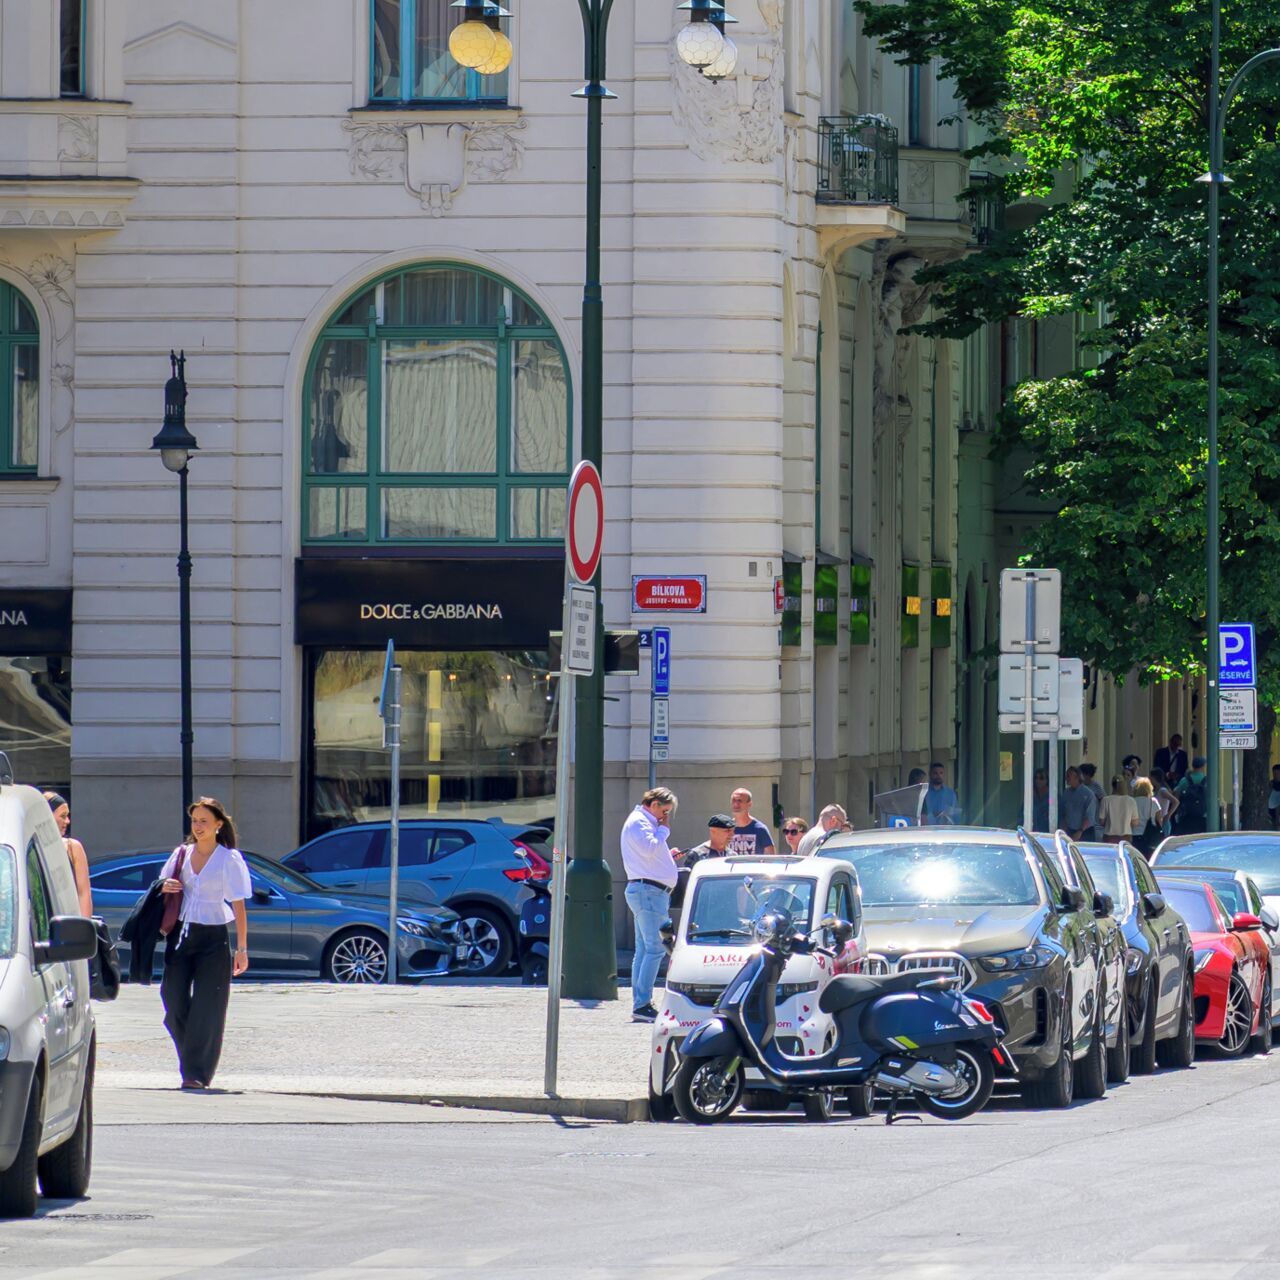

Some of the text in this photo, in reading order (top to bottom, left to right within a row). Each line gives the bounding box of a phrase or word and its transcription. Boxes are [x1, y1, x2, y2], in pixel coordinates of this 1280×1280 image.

[652, 584, 685, 596] BÍLKOVA
[657, 637, 667, 673] P
[1220, 632, 1244, 667] P
[1219, 670, 1251, 679] ÉSERVÉ
